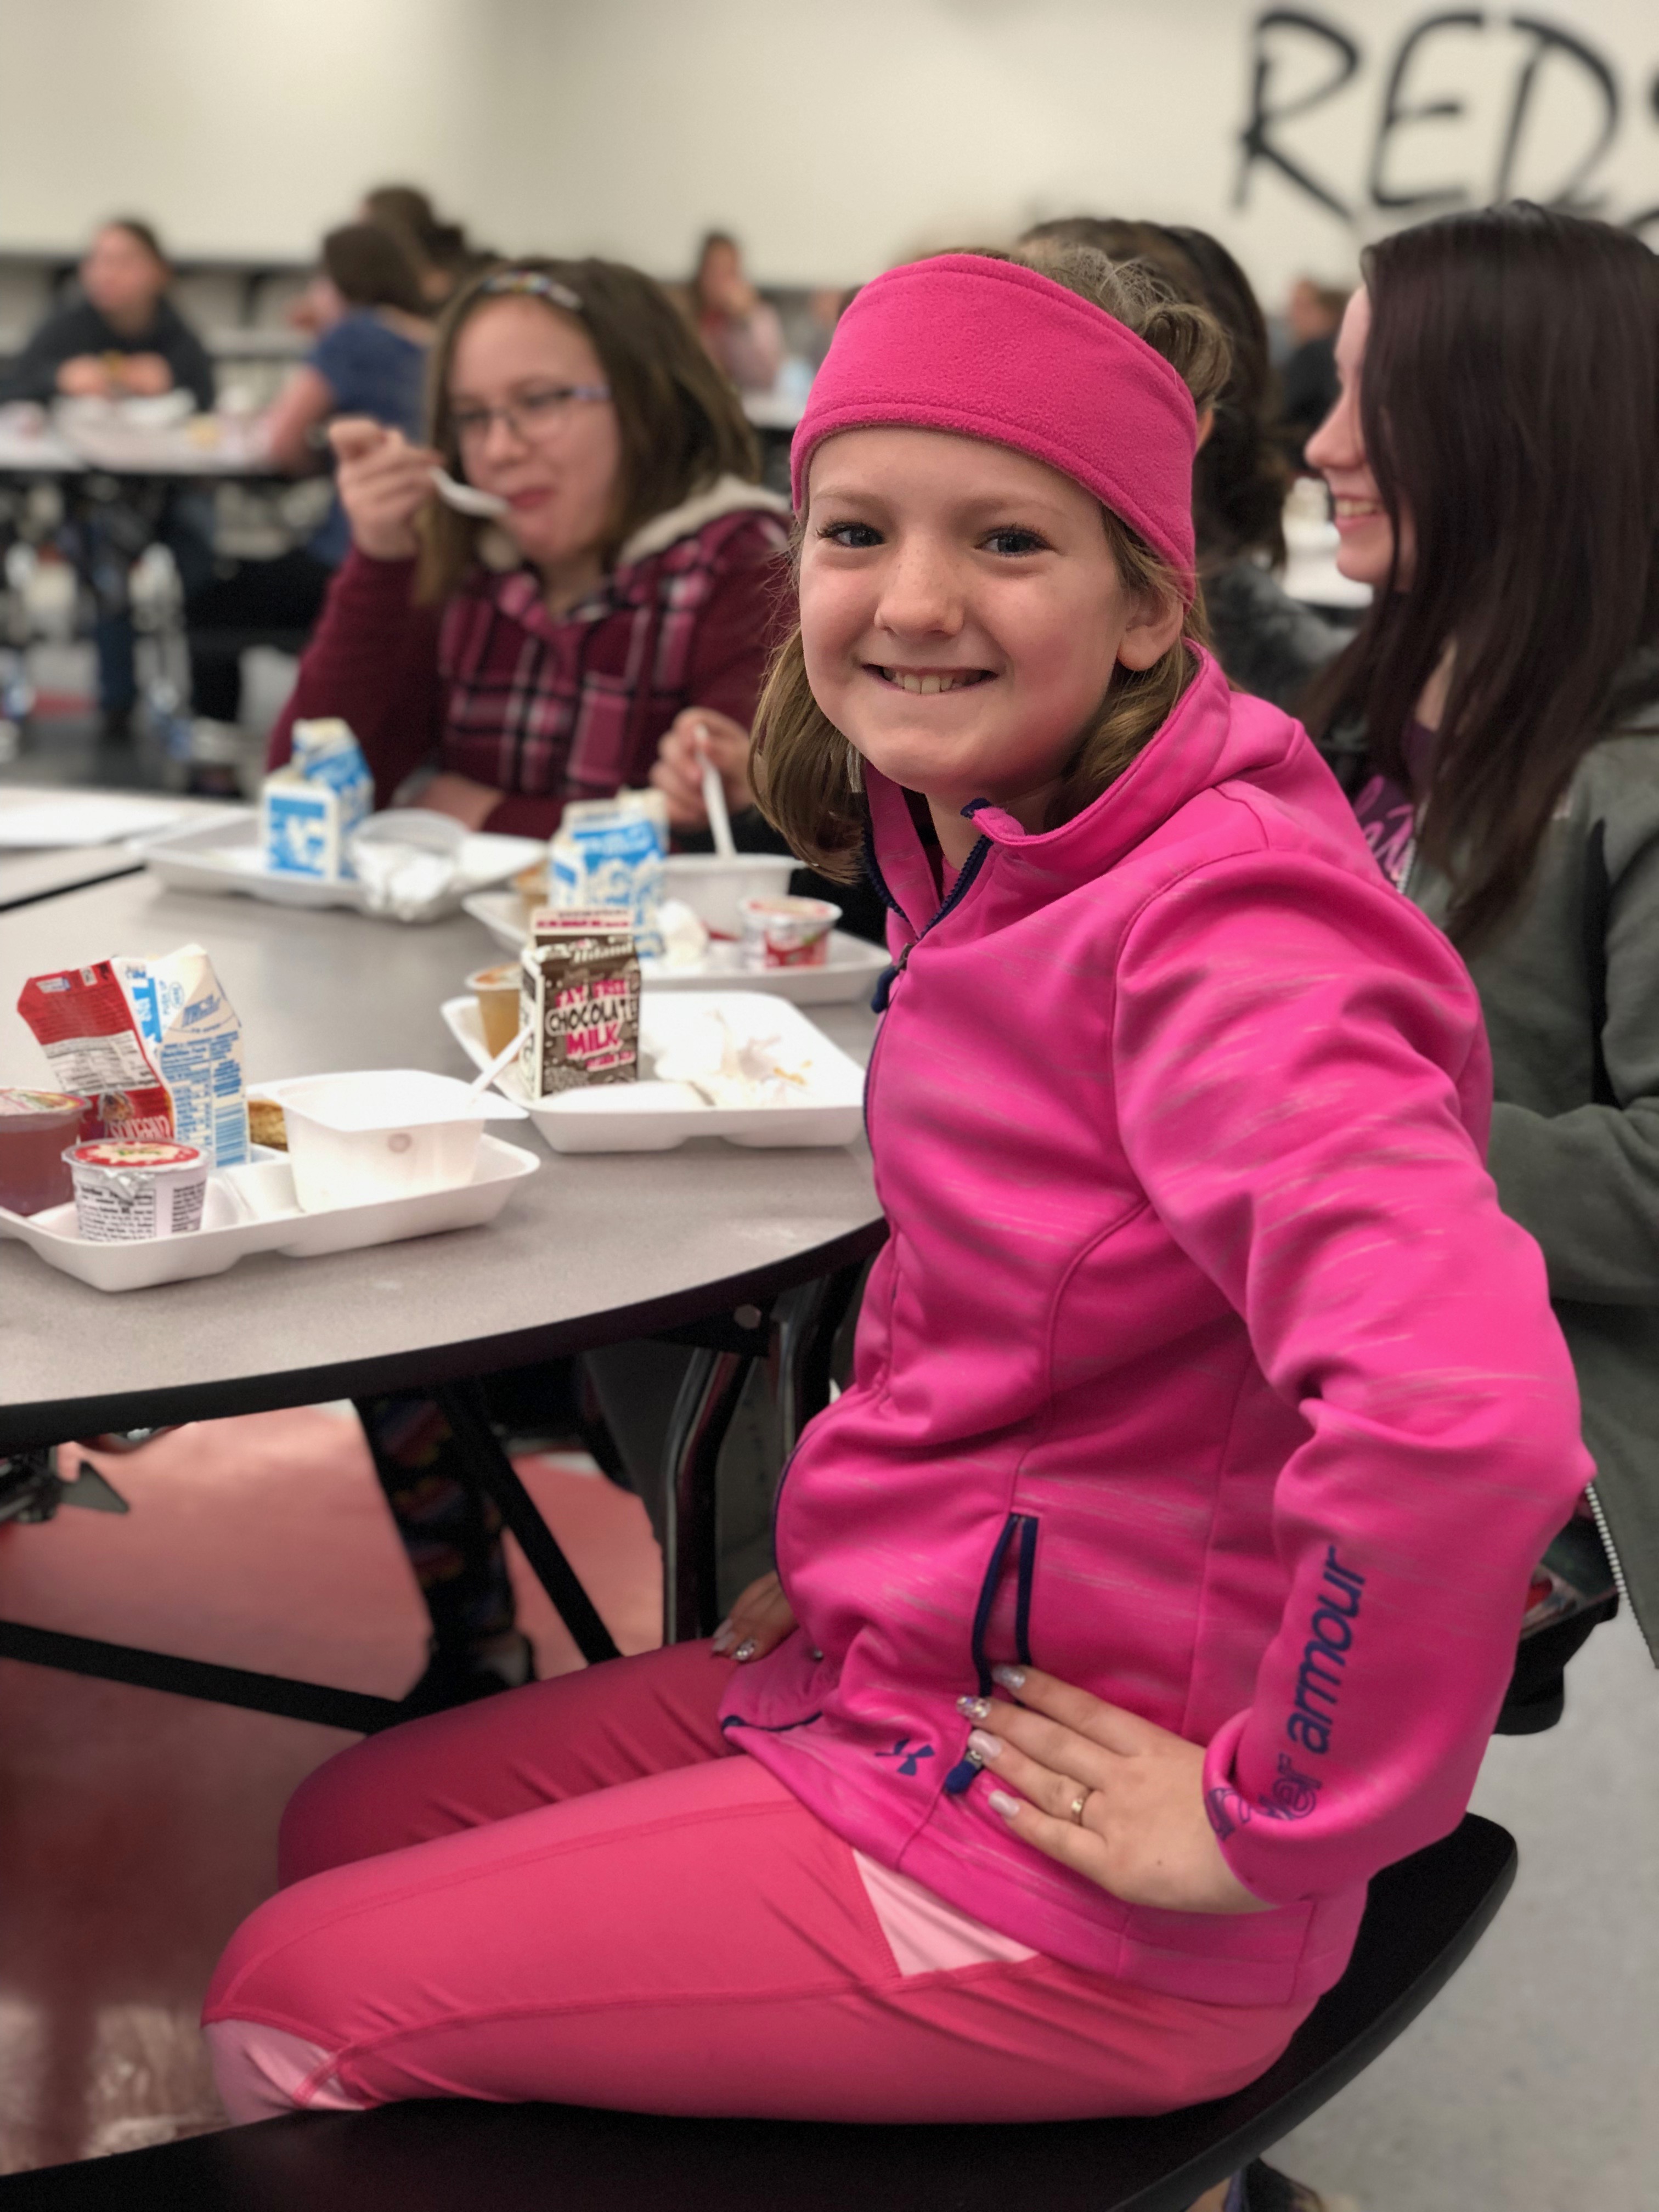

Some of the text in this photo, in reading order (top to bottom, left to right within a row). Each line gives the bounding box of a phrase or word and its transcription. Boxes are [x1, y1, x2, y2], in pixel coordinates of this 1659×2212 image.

[1232, 10, 1659, 226] RED
[565, 1020, 624, 1060] MILK
[1287, 1545, 1365, 1754] armour
